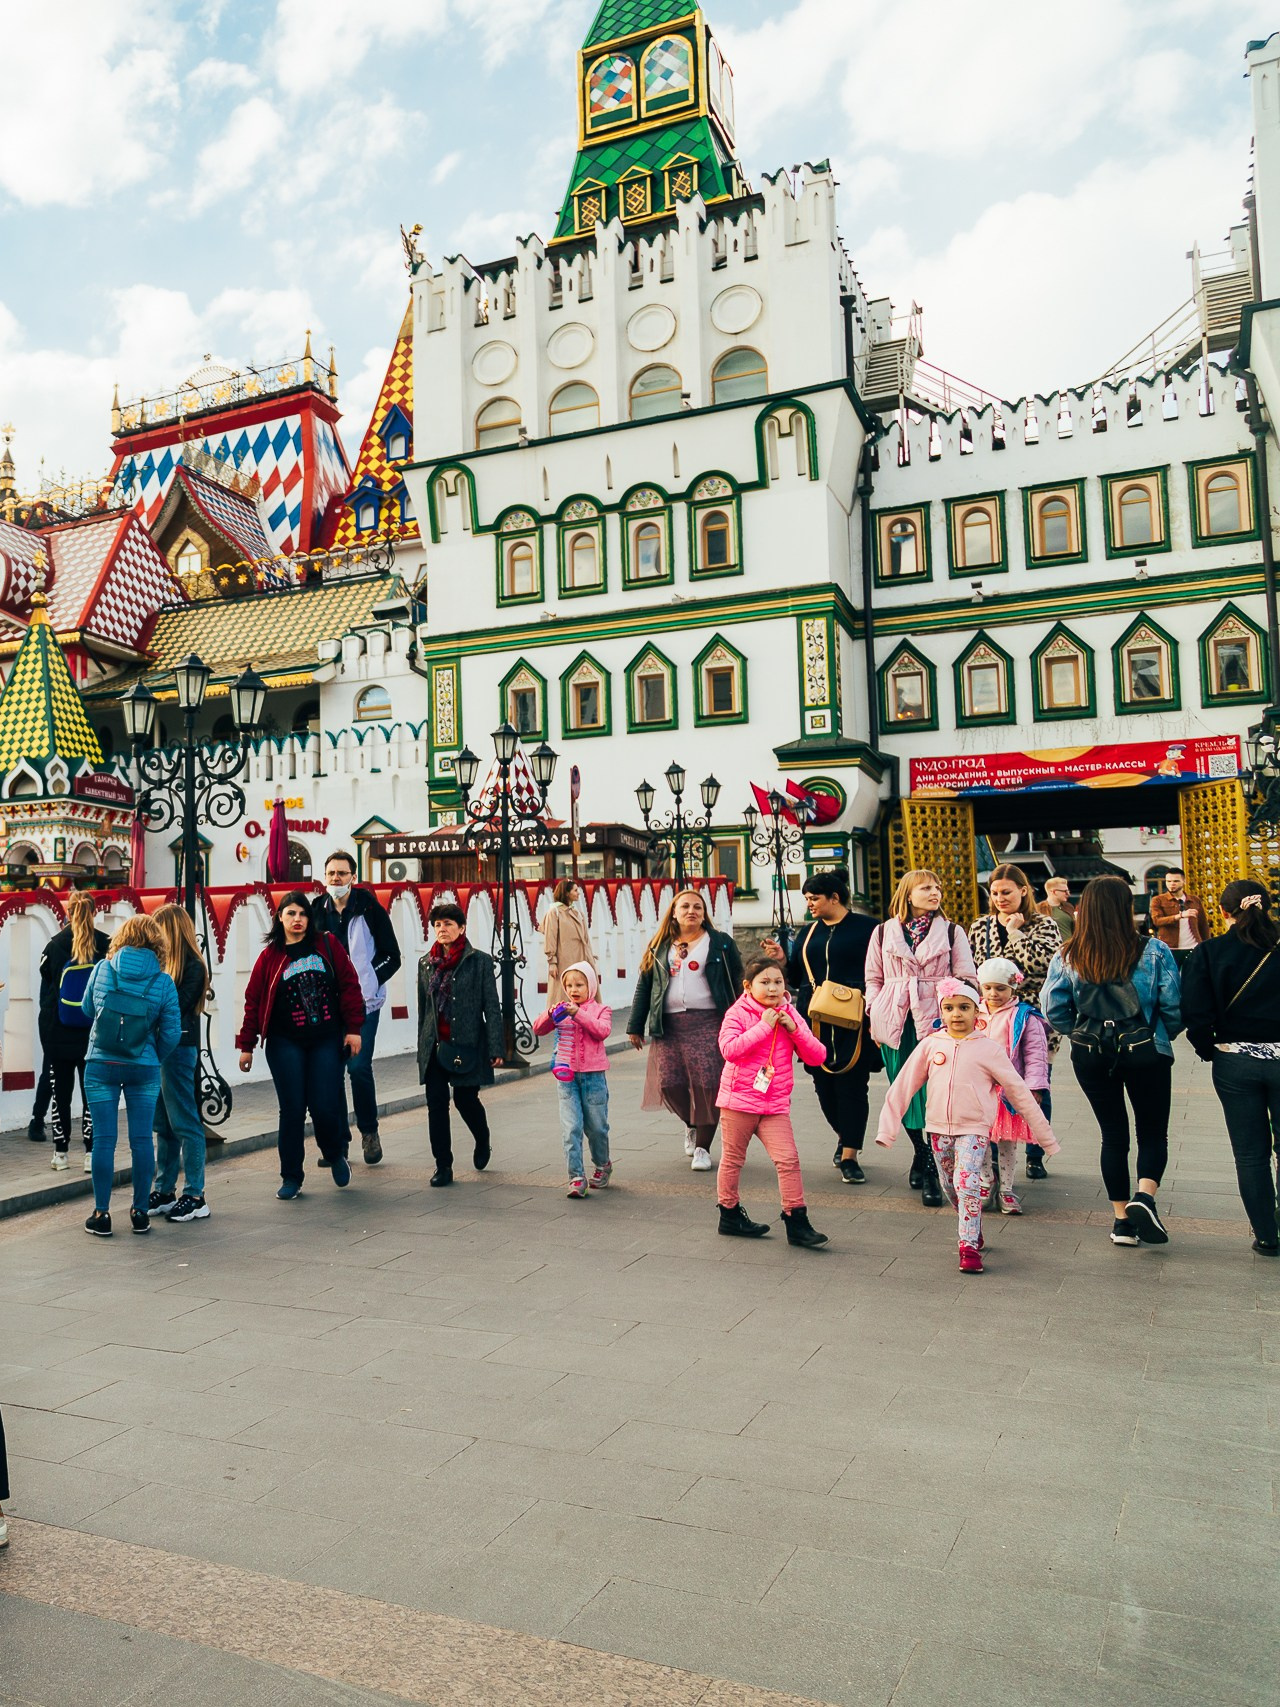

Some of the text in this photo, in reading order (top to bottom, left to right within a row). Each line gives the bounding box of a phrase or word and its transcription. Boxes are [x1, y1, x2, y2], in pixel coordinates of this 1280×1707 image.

[915, 760, 1147, 783] ДНИ РОЖДЕНИЯ ВЫПУСКНЫЕ МАСТЕР-КЛАССЫ
[915, 780, 970, 790] ЭКСКУРСИИ
[972, 779, 991, 787] ДЛЯ
[993, 775, 1023, 787] ДЕТЕЙ
[264, 797, 305, 810] КФЕ
[399, 839, 460, 853] КРЕМЛЬ
